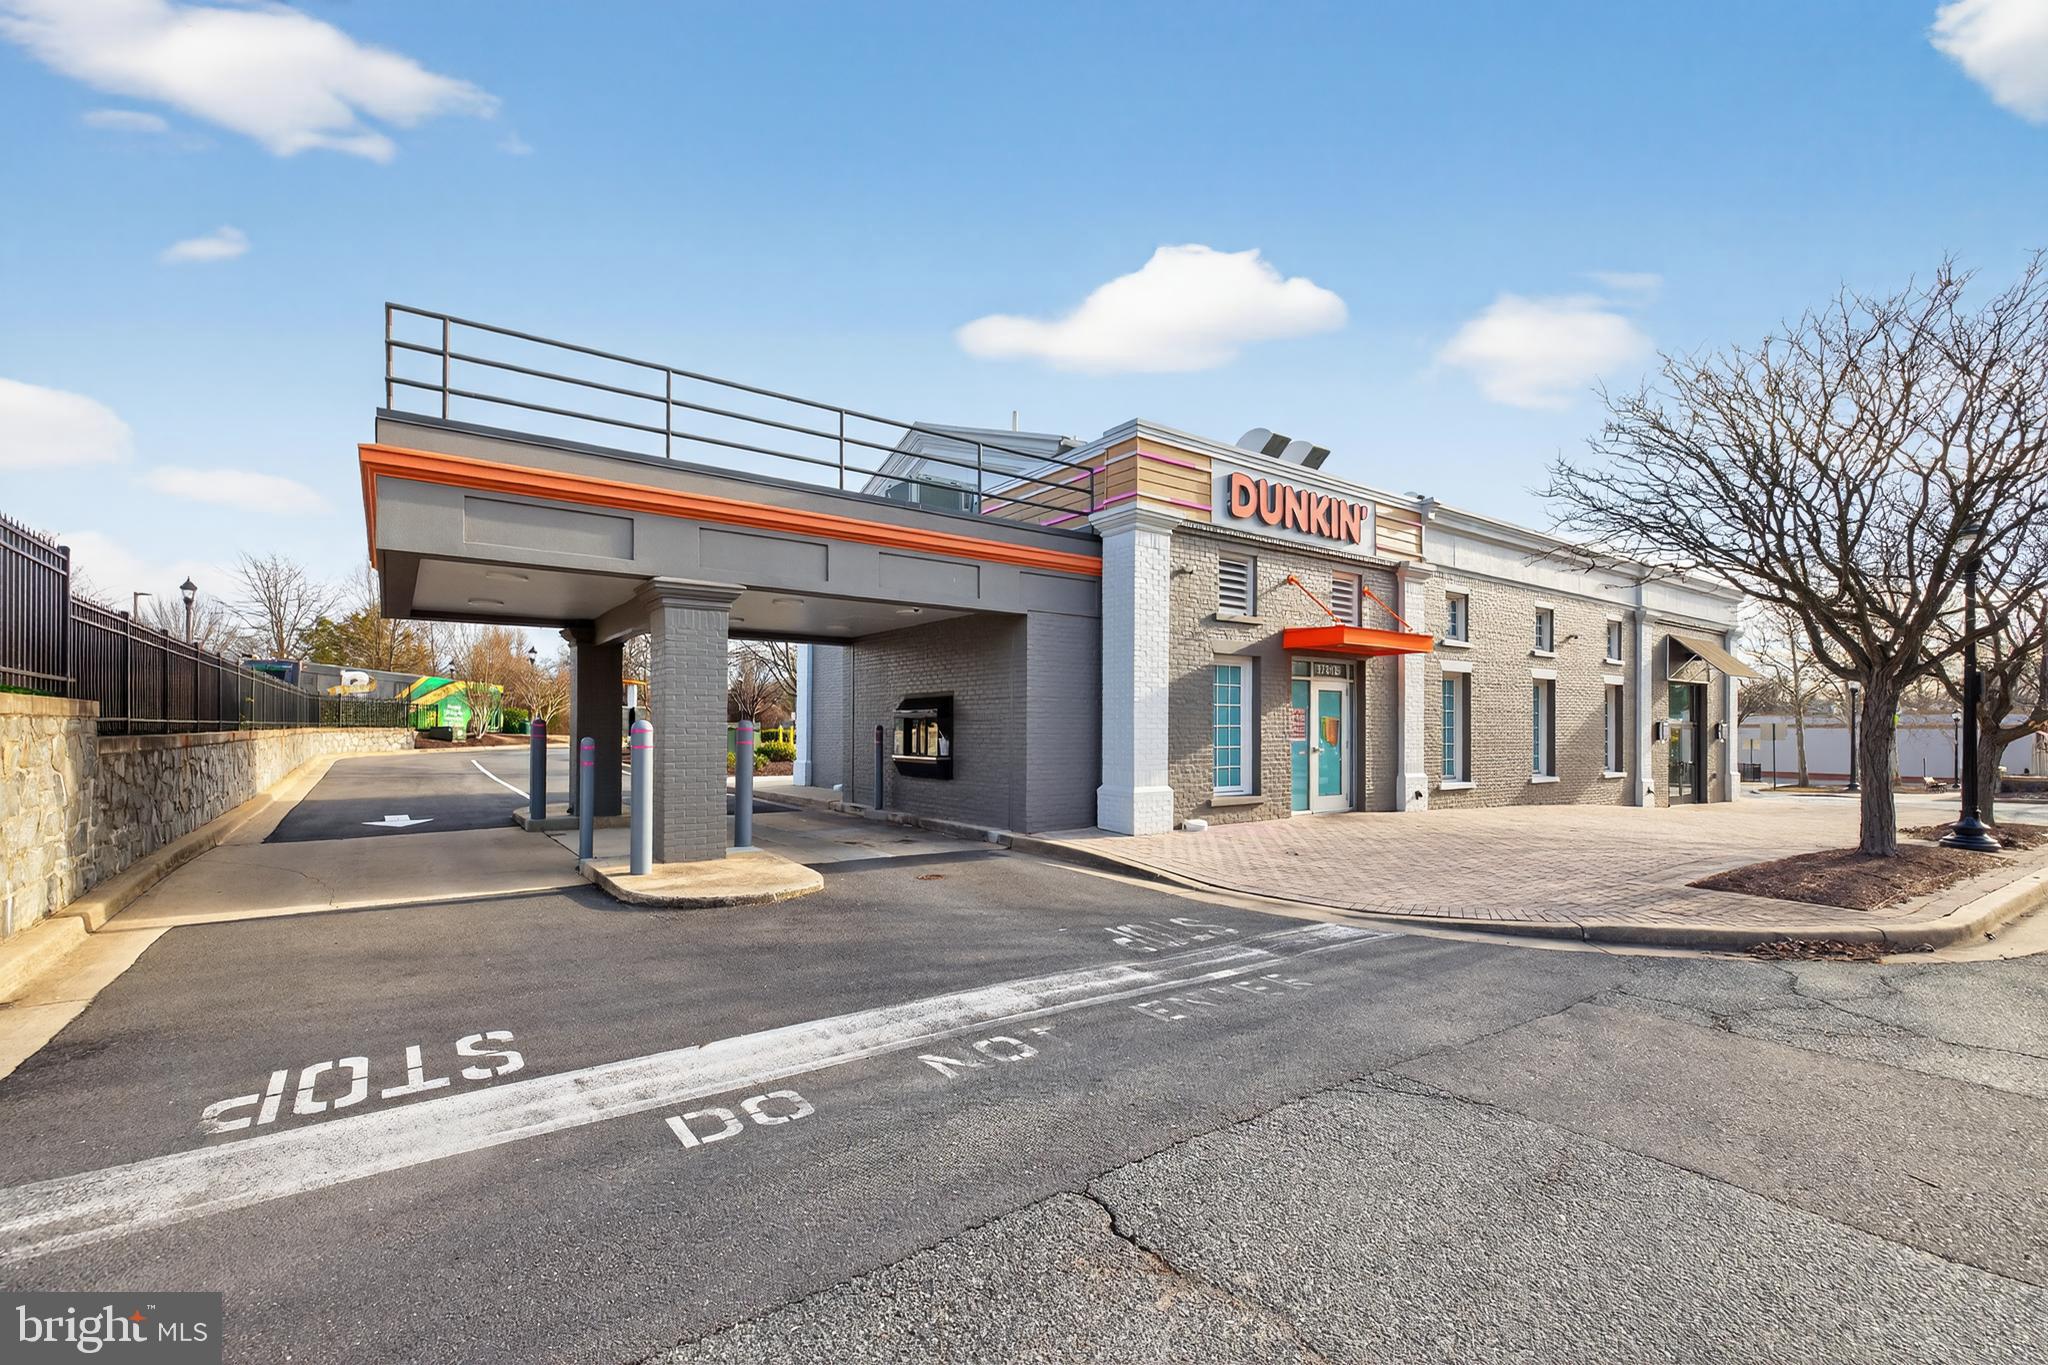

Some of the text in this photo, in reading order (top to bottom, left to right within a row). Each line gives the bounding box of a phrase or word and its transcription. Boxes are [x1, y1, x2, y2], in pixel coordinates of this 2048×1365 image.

[1228, 472, 1368, 545] DUNKIN'
[199, 1030, 525, 1134] STOP
[665, 1088, 815, 1149] DO
